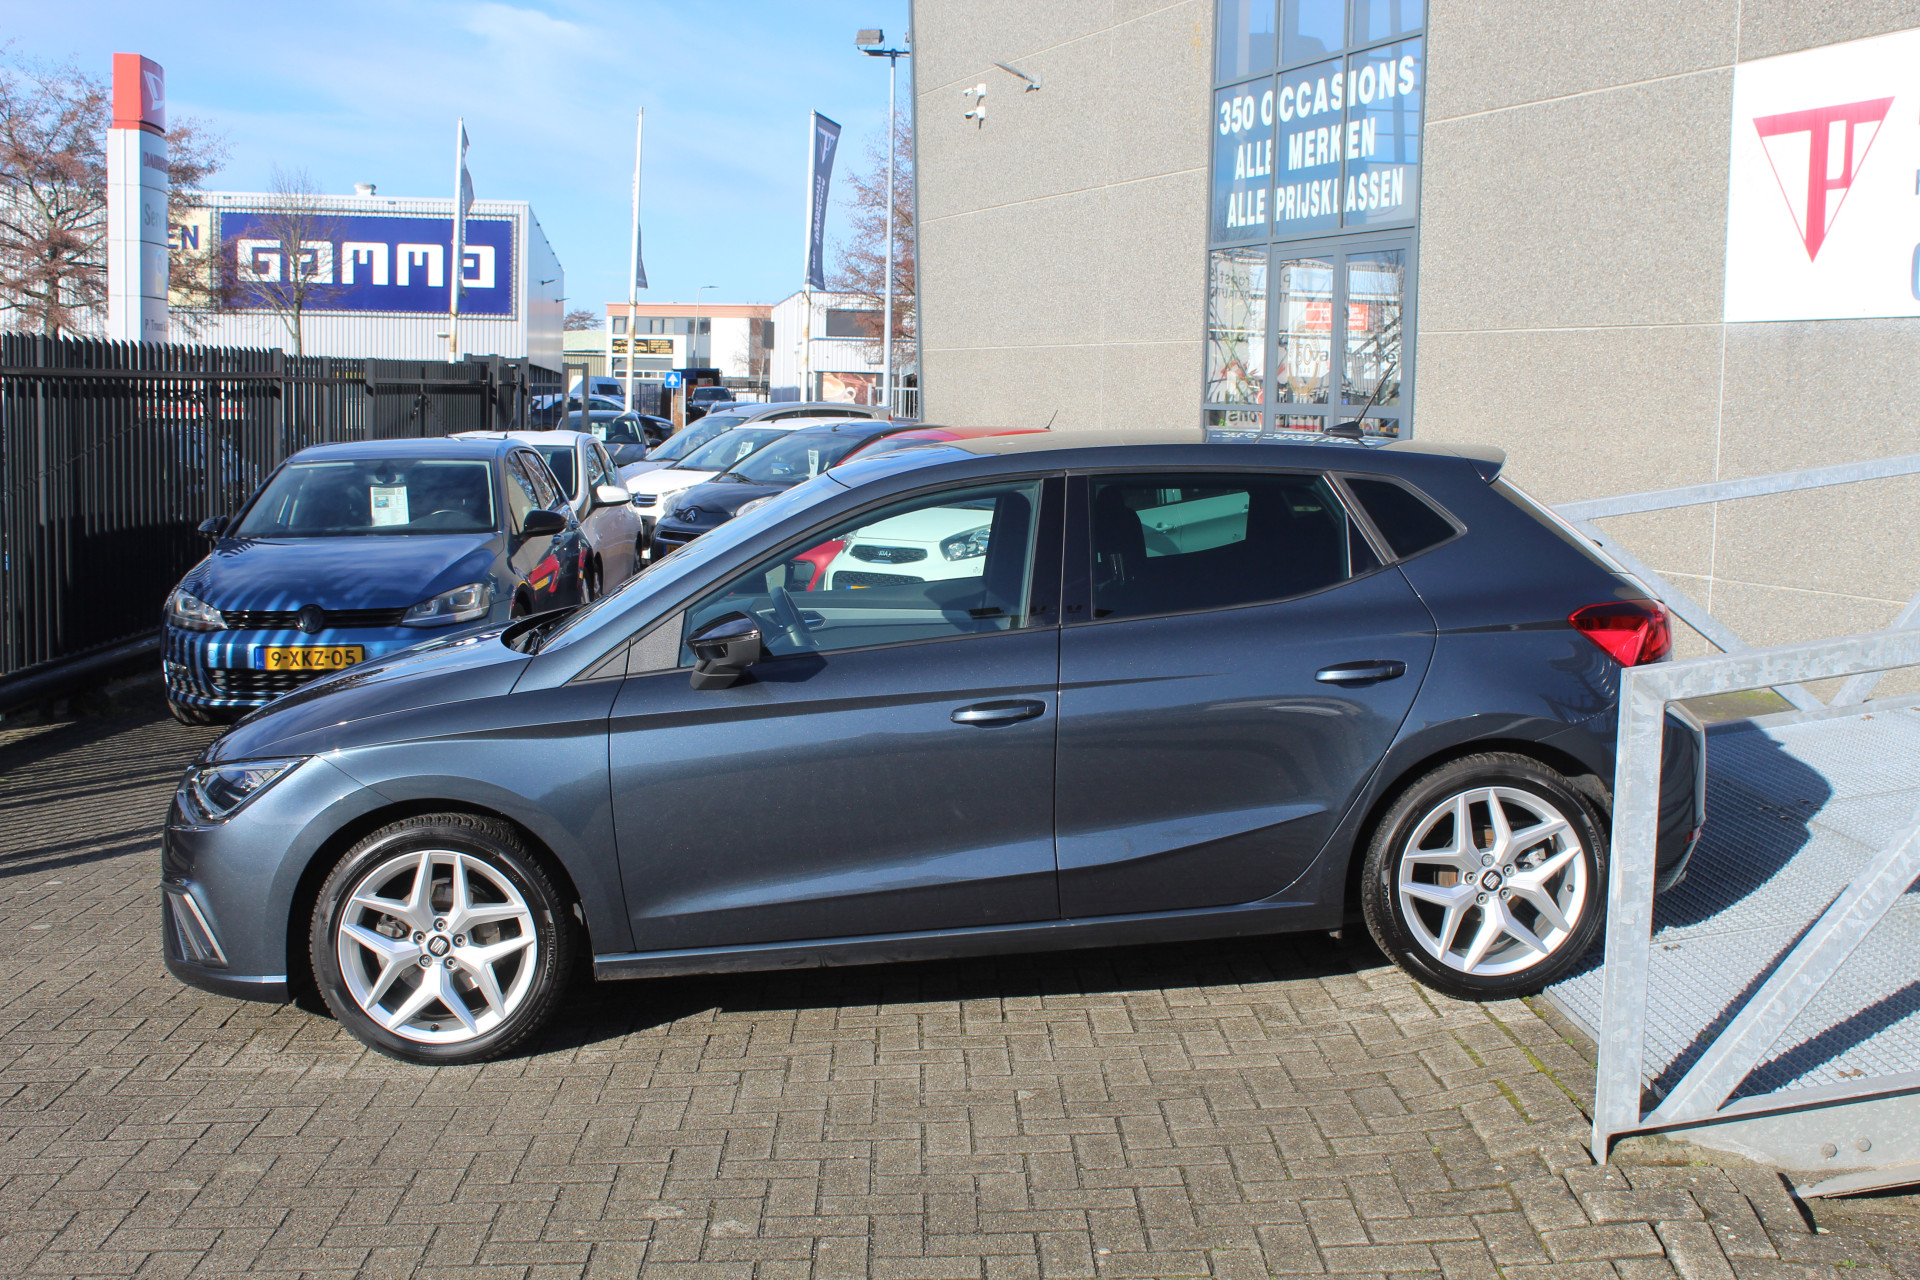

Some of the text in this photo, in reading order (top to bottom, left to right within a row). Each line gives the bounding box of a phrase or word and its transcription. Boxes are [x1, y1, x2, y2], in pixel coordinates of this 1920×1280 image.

[1220, 55, 1415, 136] 350 OCCASIONS
[1234, 116, 1376, 181] ALLE MERKEN
[1226, 167, 1404, 229] ALLE PRIJSKLASSEN
[270, 649, 356, 667] 9-XKZ-05
